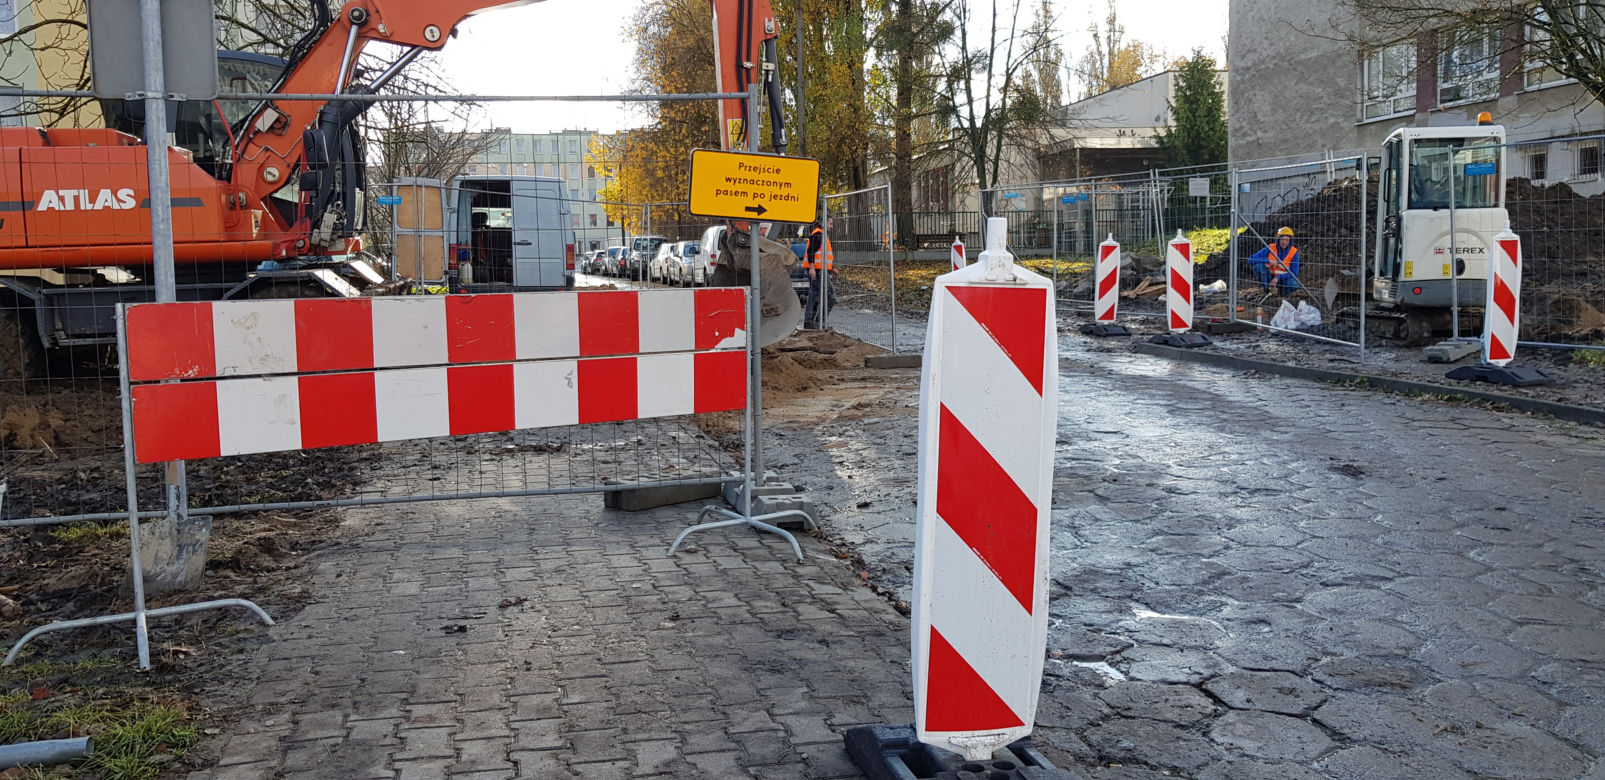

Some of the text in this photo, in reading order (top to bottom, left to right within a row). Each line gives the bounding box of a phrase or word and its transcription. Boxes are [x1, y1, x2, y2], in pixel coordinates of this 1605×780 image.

[739, 162, 781, 175] Przejście
[725, 176, 792, 189] wyznaczonym
[37, 188, 136, 211] ATLAS
[715, 188, 800, 202] pasem po jezdni
